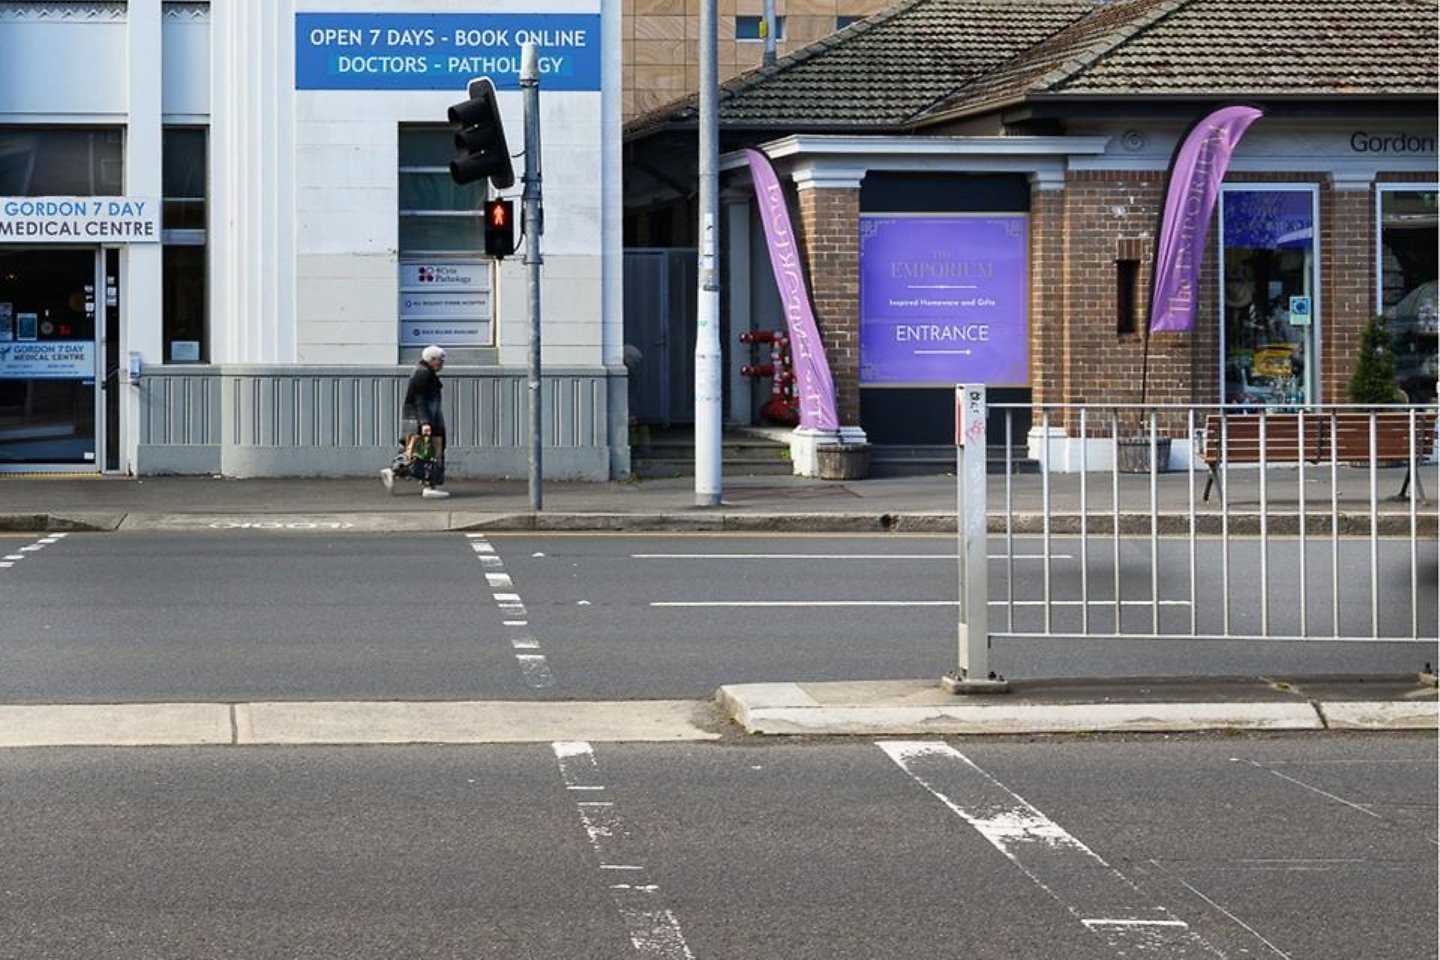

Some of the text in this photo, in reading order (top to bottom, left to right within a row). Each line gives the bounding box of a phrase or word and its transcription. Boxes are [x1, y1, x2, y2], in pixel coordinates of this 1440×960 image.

[310, 29, 361, 46] OPEN
[369, 29, 380, 46] 7
[387, 29, 435, 46] DAYS
[455, 29, 509, 47] BOOK
[515, 29, 586, 47] ONLINE
[338, 56, 428, 73] DOCTORS
[448, 56, 563, 73] PATHOLGY
[1350, 131, 1435, 153] Gordon
[4, 201, 145, 216] GORDON 7 DAY
[85, 221, 154, 236] CENTRE
[890, 262, 995, 279] EMPORIUM
[1168, 279, 1192, 318] The
[896, 324, 989, 341] ENTRANCE
[13, 345, 84, 353] GORDON 7 DAY
